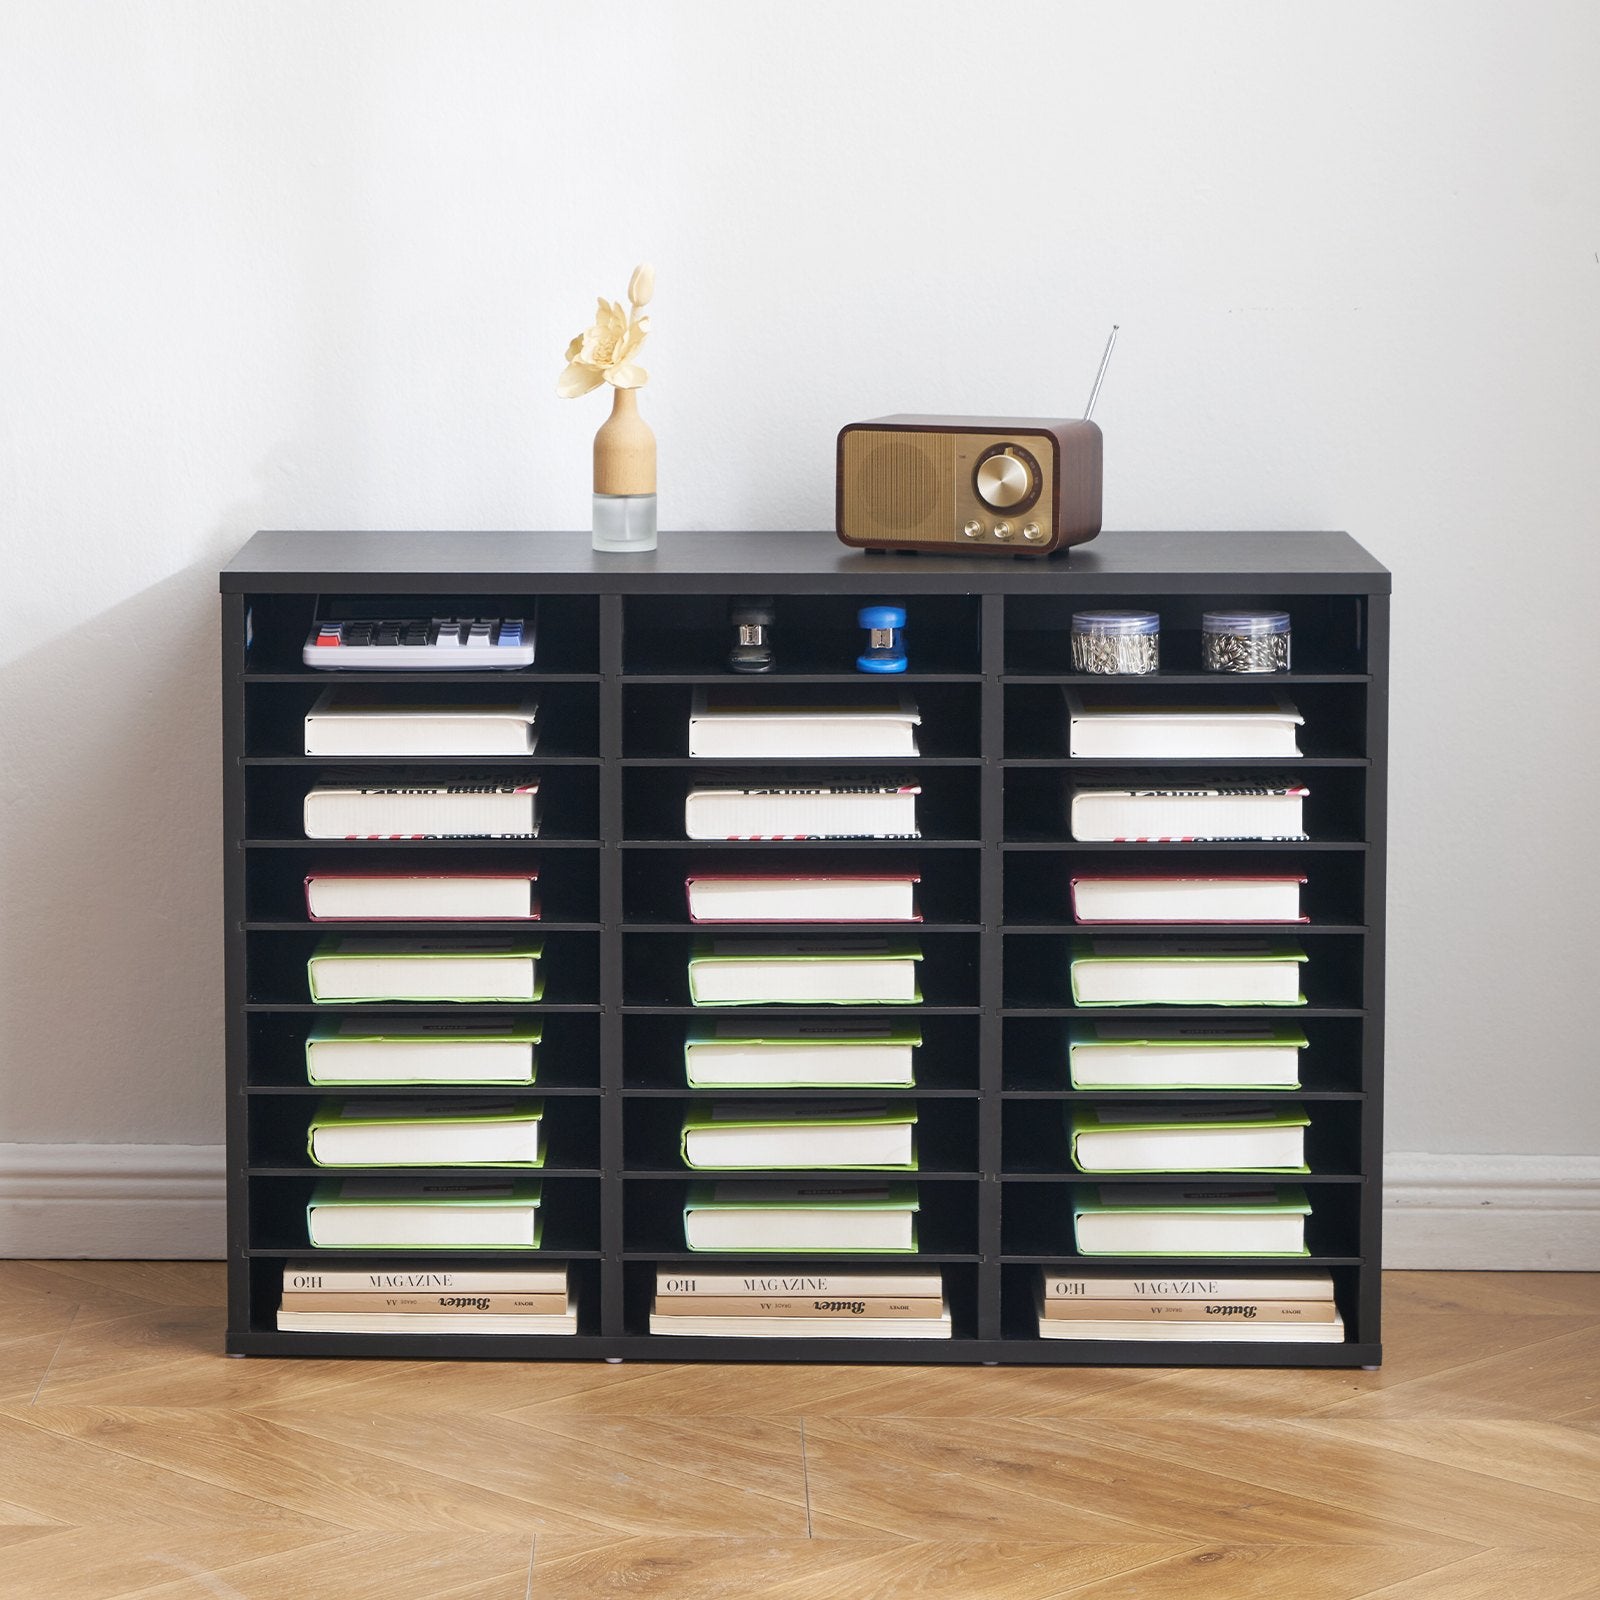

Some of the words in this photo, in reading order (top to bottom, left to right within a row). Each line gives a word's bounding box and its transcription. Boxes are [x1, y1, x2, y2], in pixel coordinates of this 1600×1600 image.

[369, 1274, 453, 1288] MAGAZINE
[743, 1278, 828, 1291] MAGAZINE
[1133, 1281, 1218, 1294] MAGAZINE
[437, 1297, 490, 1311] Butter
[812, 1301, 866, 1315] Butter
[1204, 1305, 1257, 1319] Butter
